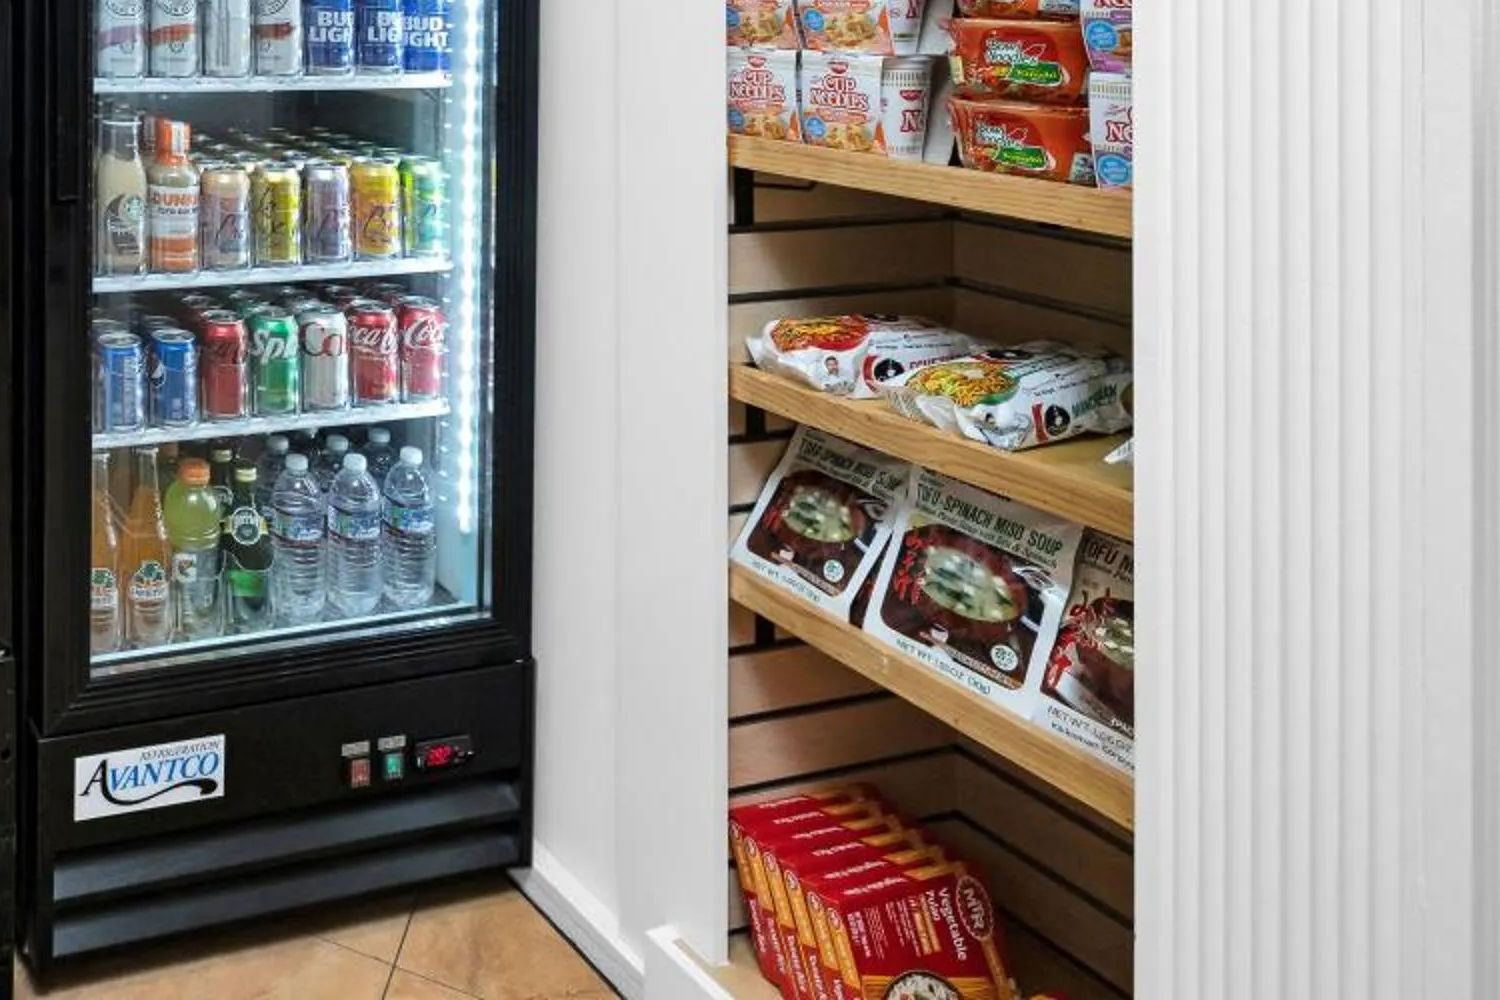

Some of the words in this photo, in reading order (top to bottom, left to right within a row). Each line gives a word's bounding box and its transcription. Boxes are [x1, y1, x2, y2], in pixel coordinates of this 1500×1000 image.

[308, 27, 355, 43] LIGH
[403, 31, 449, 47] IGHT
[822, 75, 857, 92] CUP
[809, 90, 870, 112] NOODLES
[78, 750, 220, 806] AVANTCO
[937, 886, 969, 963] Vegetable
